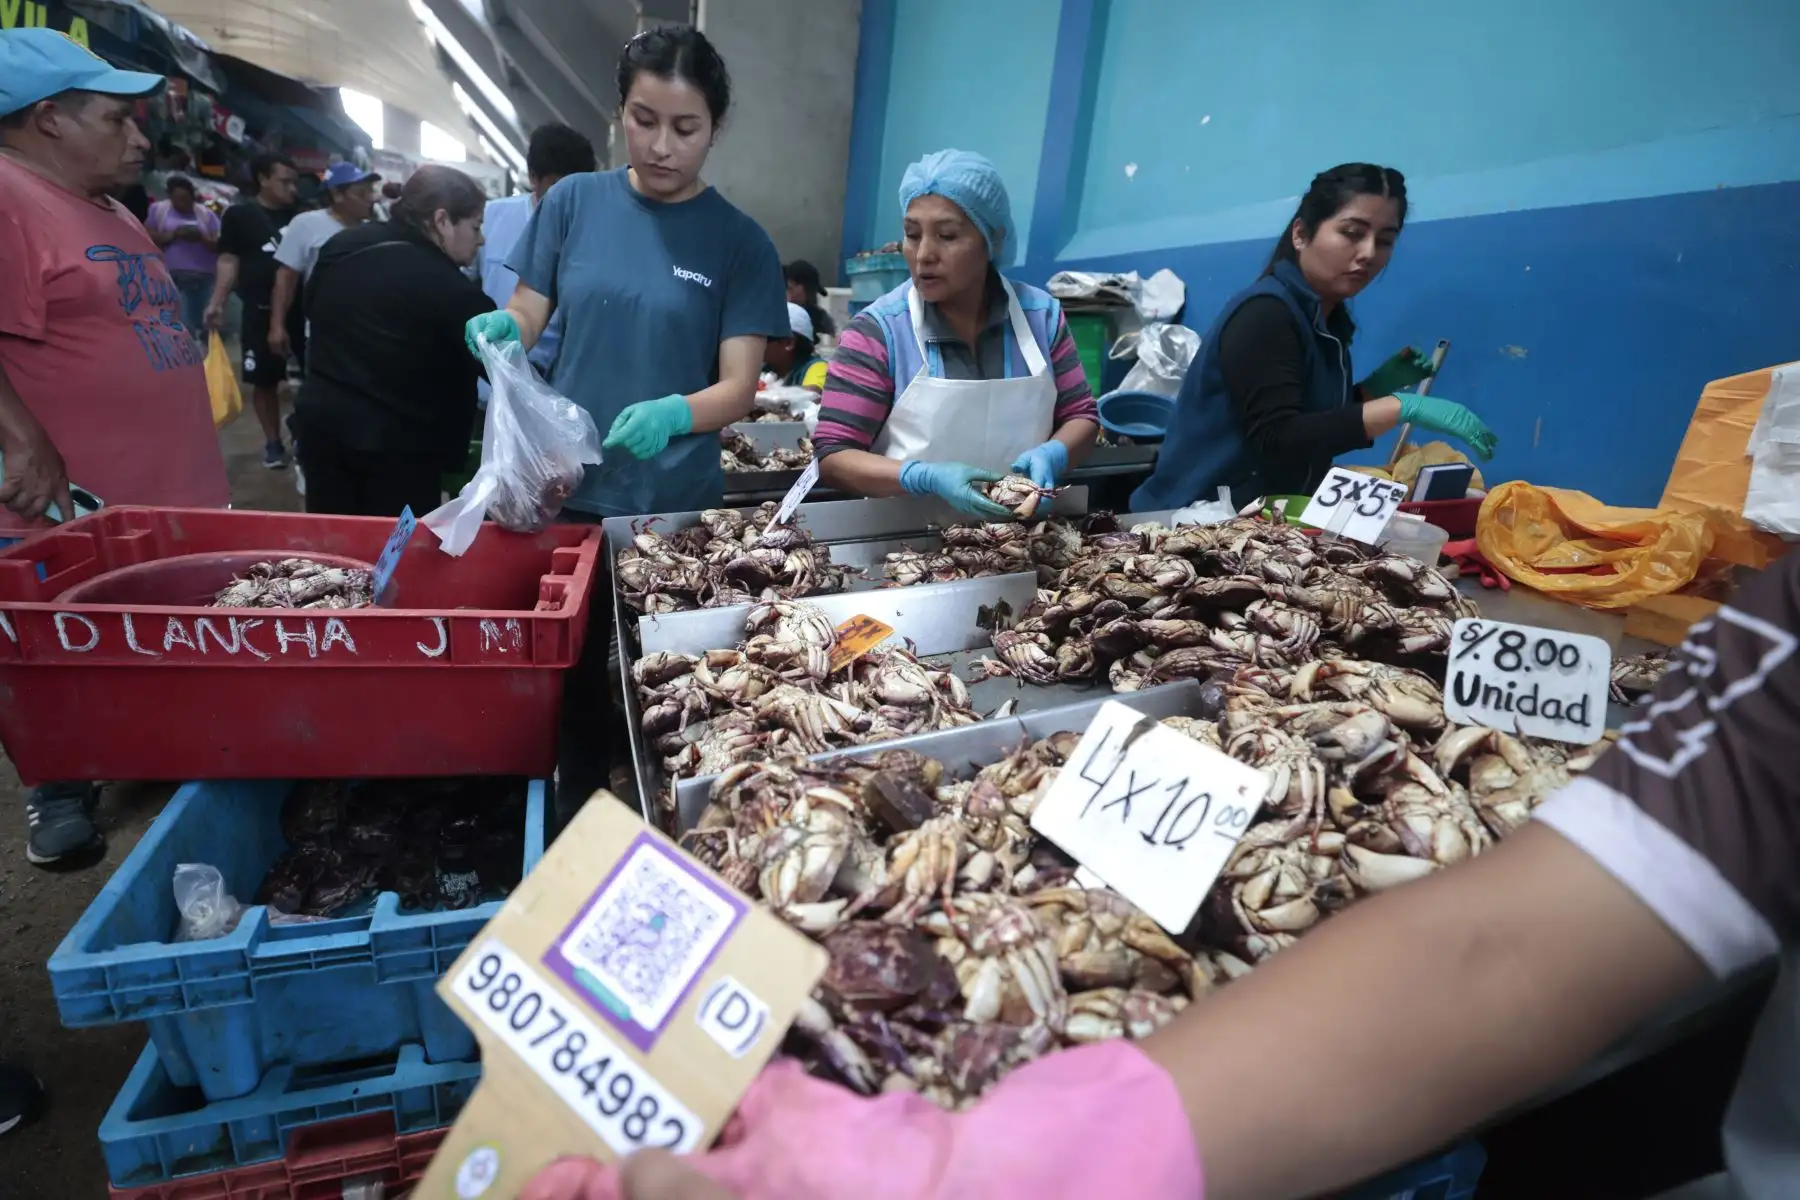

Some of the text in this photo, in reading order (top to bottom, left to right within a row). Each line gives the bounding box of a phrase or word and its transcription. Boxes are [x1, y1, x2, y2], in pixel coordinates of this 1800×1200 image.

[54, 611, 100, 651] D
[122, 611, 358, 661] LANCHA
[416, 616, 447, 657] J
[1453, 671, 1591, 727] Unidad
[699, 982, 766, 1052] (D)
[468, 953, 686, 1148] 980784982
